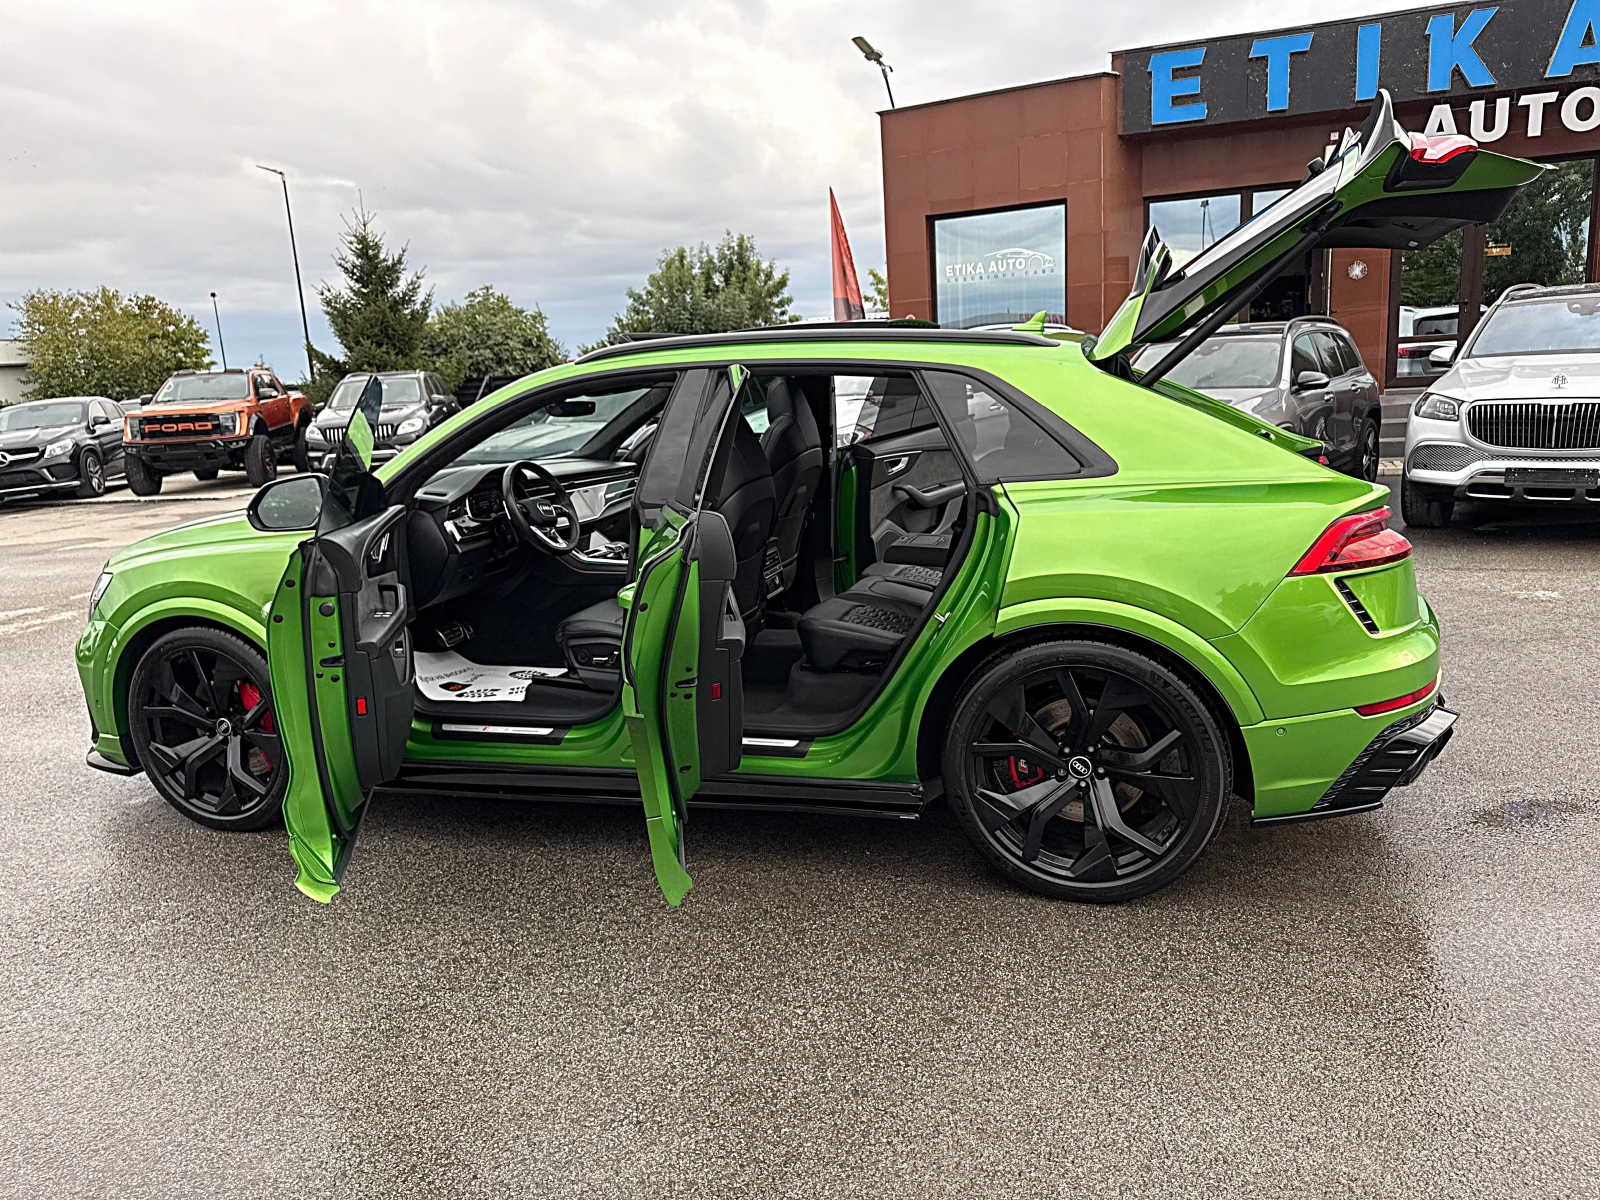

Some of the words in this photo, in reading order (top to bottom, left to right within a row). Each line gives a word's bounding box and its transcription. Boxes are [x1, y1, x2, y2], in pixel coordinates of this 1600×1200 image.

[1147, 0, 1600, 126] ETIKA
[1423, 86, 1600, 143] AUTO
[945, 261, 985, 277] ETIKA
[988, 257, 1026, 273] AUTO
[144, 421, 213, 434] FORD
